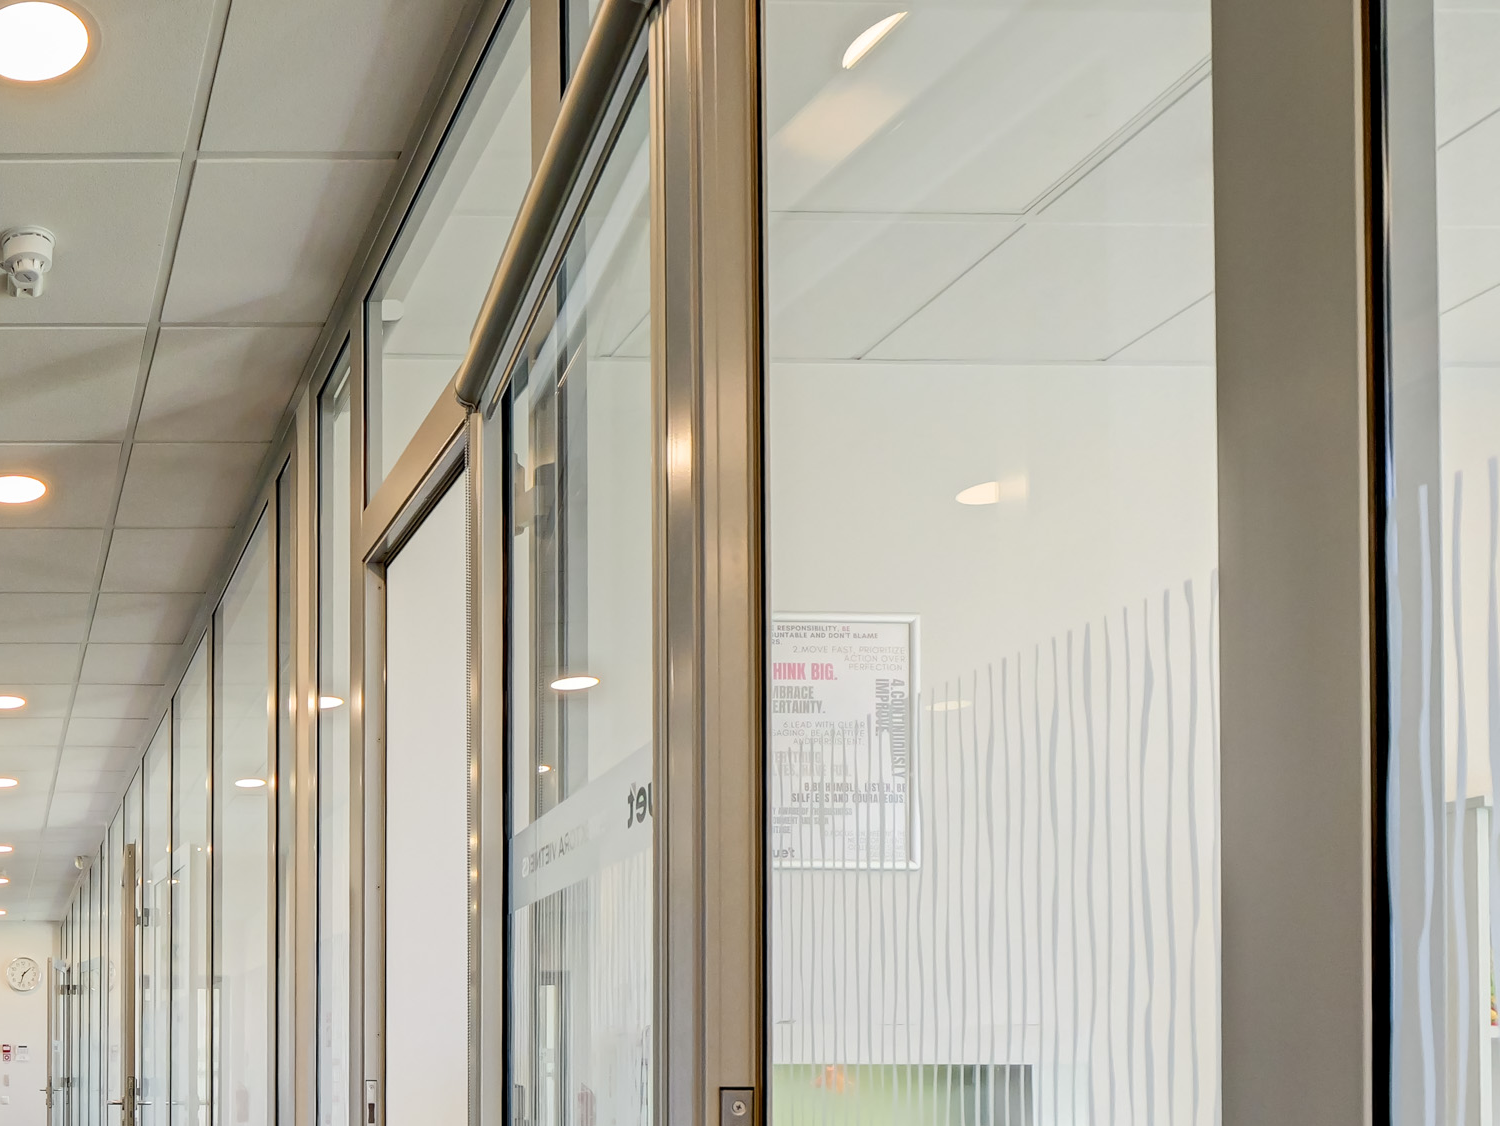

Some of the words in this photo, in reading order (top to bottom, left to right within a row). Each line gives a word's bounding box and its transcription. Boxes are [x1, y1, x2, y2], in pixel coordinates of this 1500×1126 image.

[858, 646, 906, 655] PRIORITIZE
[844, 654, 878, 663] ACTION
[880, 655, 906, 663] OVER
[773, 662, 807, 680] HINK
[811, 662, 839, 680] BIG.
[772, 685, 814, 699] MBRACE
[773, 700, 826, 714] ERTAINTY.
[815, 720, 835, 729] WITH
[810, 729, 821, 737] BE
[772, 846, 796, 859] uet
